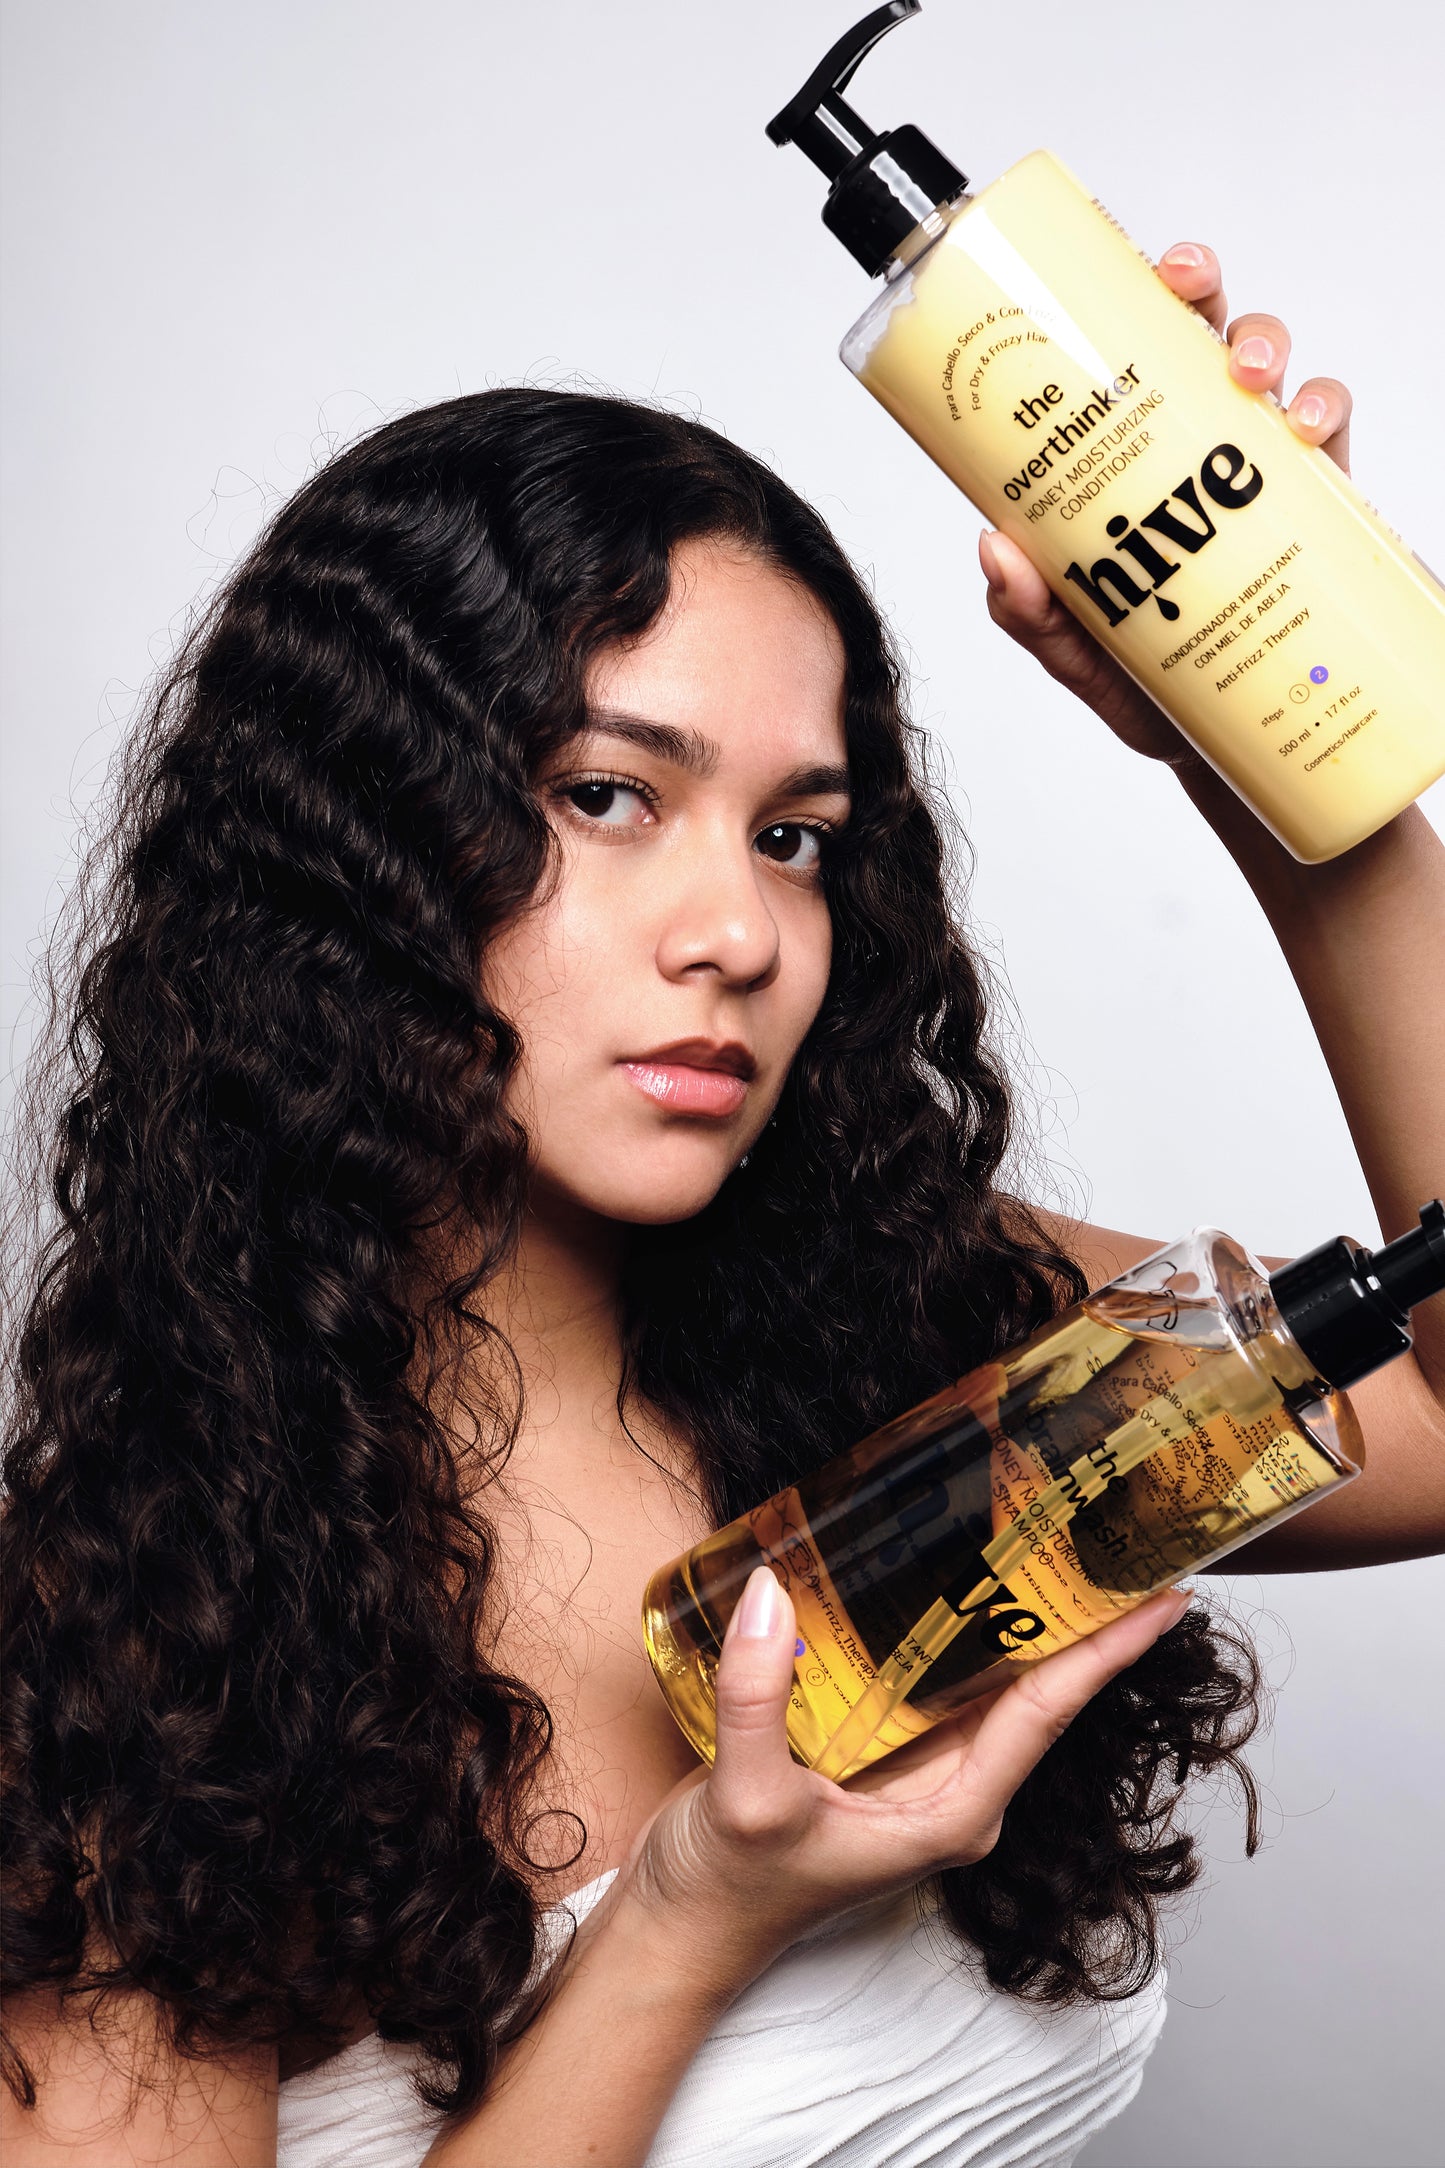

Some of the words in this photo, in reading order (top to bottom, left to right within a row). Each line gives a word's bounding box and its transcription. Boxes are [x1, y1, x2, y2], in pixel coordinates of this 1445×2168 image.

[957, 321, 984, 347] Seco
[986, 312, 996, 324] &
[999, 306, 1024, 319] Con
[942, 347, 961, 391] Cabello
[980, 355, 990, 366] &
[988, 334, 1022, 357] Frizzy
[969, 366, 985, 388] Dry
[971, 391, 982, 412] For
[1012, 384, 1064, 430] the
[946, 394, 962, 422] Para
[1003, 363, 1140, 502] overthinker
[1024, 480, 1067, 524] HONEY
[1065, 389, 1165, 486] MOISTURIZING
[1060, 431, 1155, 521] CONDITIONER
[1063, 442, 1264, 628] hive
[1160, 601, 1241, 673] ACONDICIONADOR
[1238, 541, 1303, 604] HIDRATANTE
[1194, 647, 1218, 669] CON
[1215, 629, 1242, 652] MIEL
[1238, 612, 1257, 631] DE
[1256, 583, 1292, 617] ABEJA
[1215, 648, 1266, 693] Anti-Frizz
[1262, 607, 1310, 649] Therapy
[1261, 707, 1285, 728] steps
[1278, 739, 1299, 758] 500
[1298, 728, 1312, 743] ml
[1324, 703, 1339, 719] 17
[1339, 695, 1350, 707] fl
[1349, 685, 1363, 699] oz
[1303, 708, 1379, 773] Cosmetics/Haircare
[1111, 1376, 1139, 1388] Para
[1142, 1377, 1183, 1411] Cabello
[1086, 1439, 1129, 1495] the
[1140, 1409, 1161, 1428] Dry
[1160, 1427, 1172, 1438] &
[1168, 1437, 1186, 1473] Frizzy
[990, 1426, 1028, 1484] HONEY
[1018, 1485, 1103, 1589] MOISTURIZING
[1024, 1403, 1129, 1557] brainwash
[993, 1485, 1054, 1566] SHAMPOO
[809, 1575, 845, 1634] Anti-Frizz
[843, 1634, 880, 1681] Therapy
[791, 1698, 803, 1710] oz
